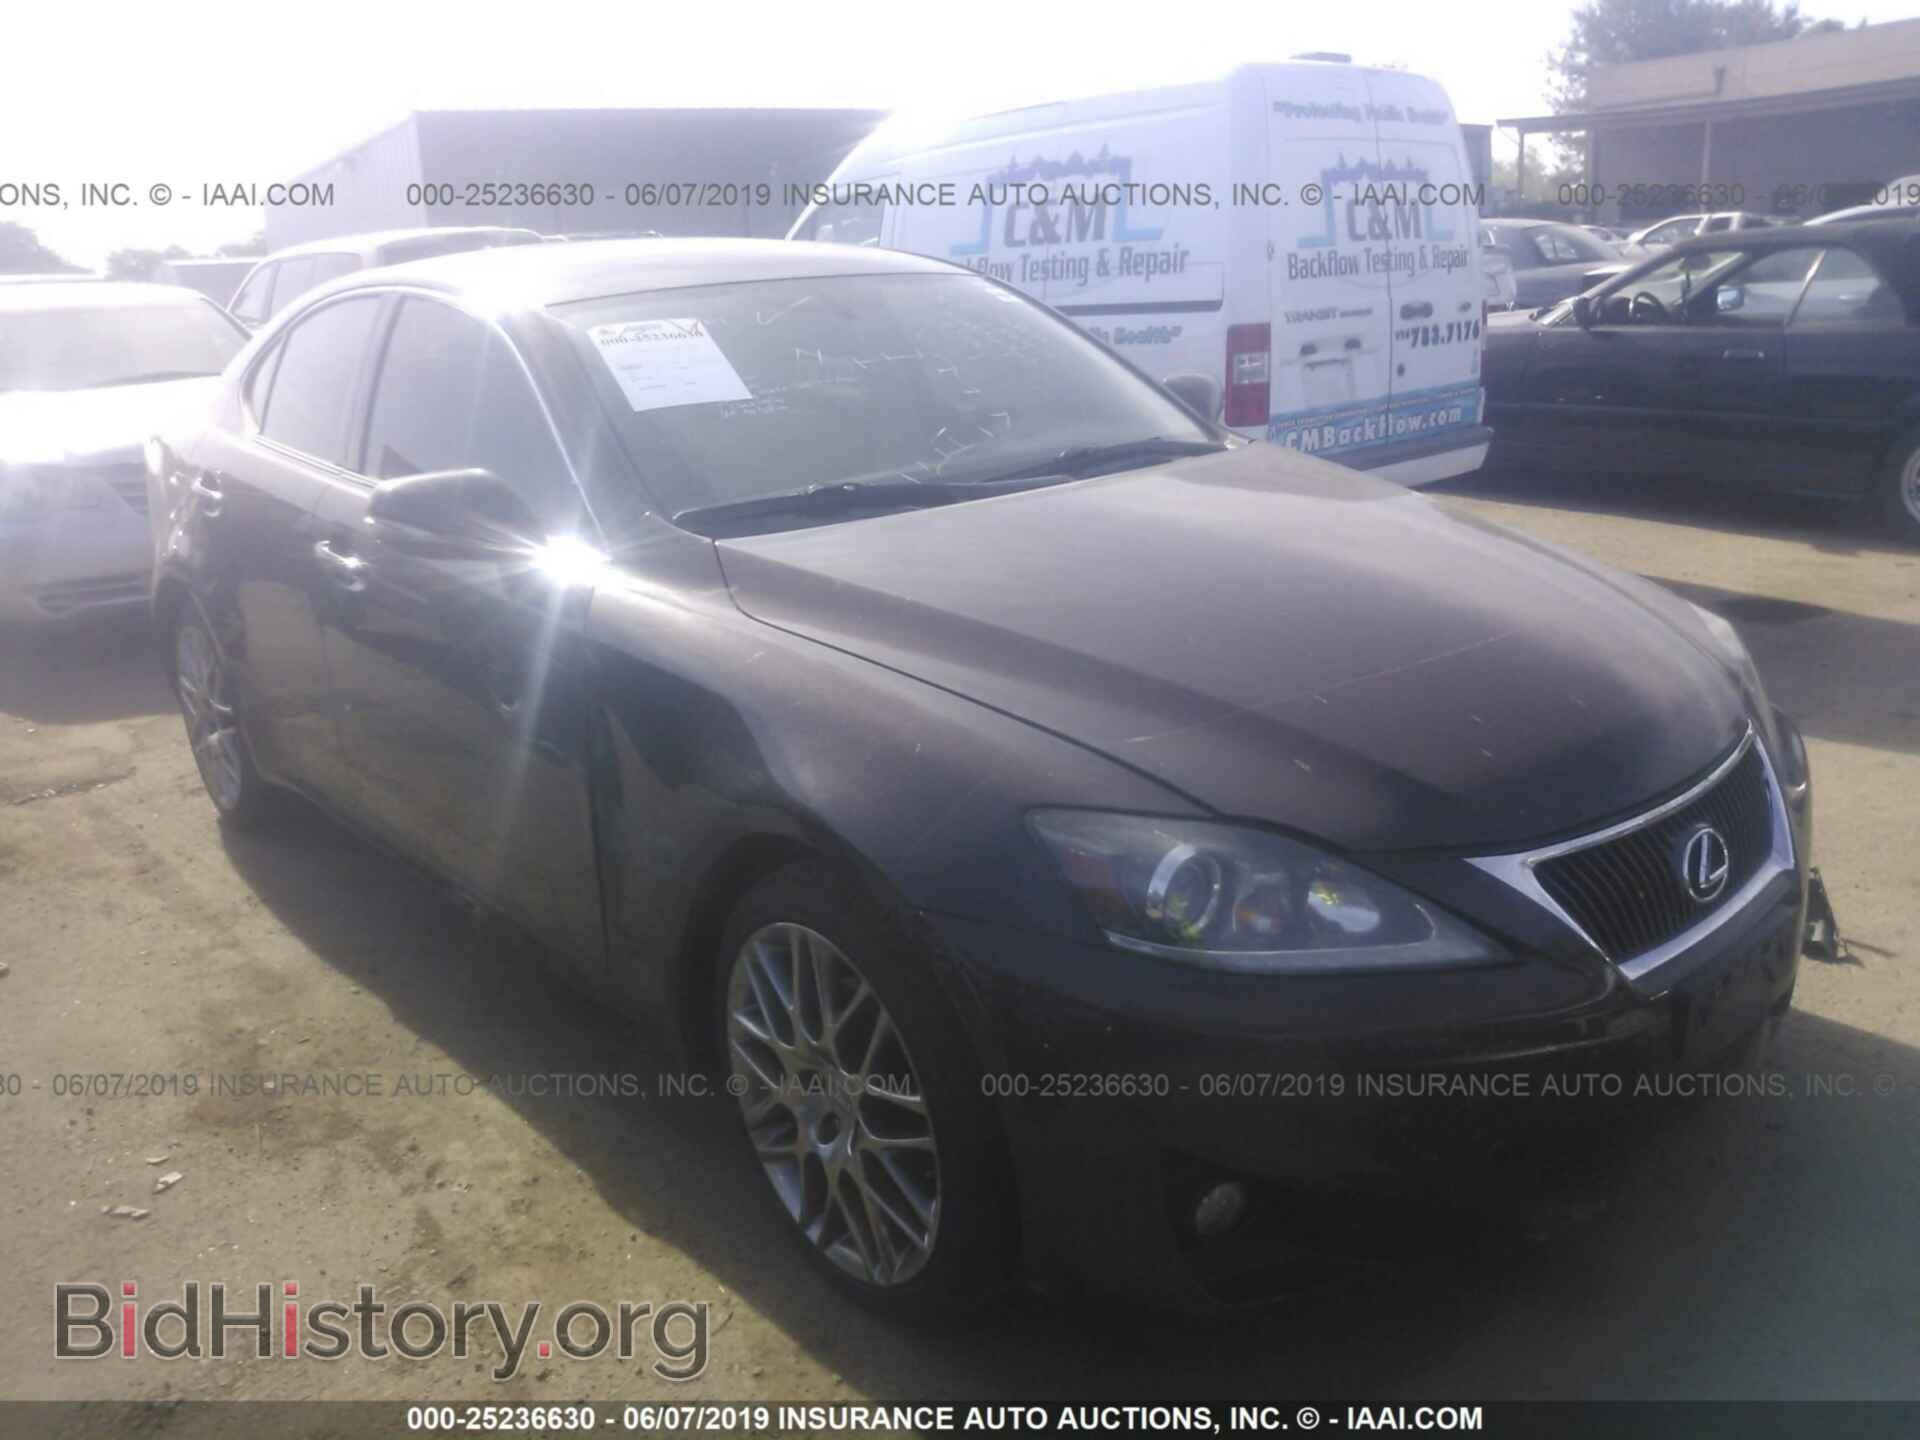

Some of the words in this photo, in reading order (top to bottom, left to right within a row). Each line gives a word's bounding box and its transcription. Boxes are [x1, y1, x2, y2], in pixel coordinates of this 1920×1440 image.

[1003, 199, 1109, 248] C&M
[1346, 199, 1423, 242] C&M
[1020, 252, 1089, 287] Testing
[1096, 248, 1112, 278] &
[1119, 243, 1190, 283] Repair
[1288, 250, 1360, 281] Backflow
[1363, 246, 1416, 277] Testing
[1432, 244, 1468, 275] Repair
